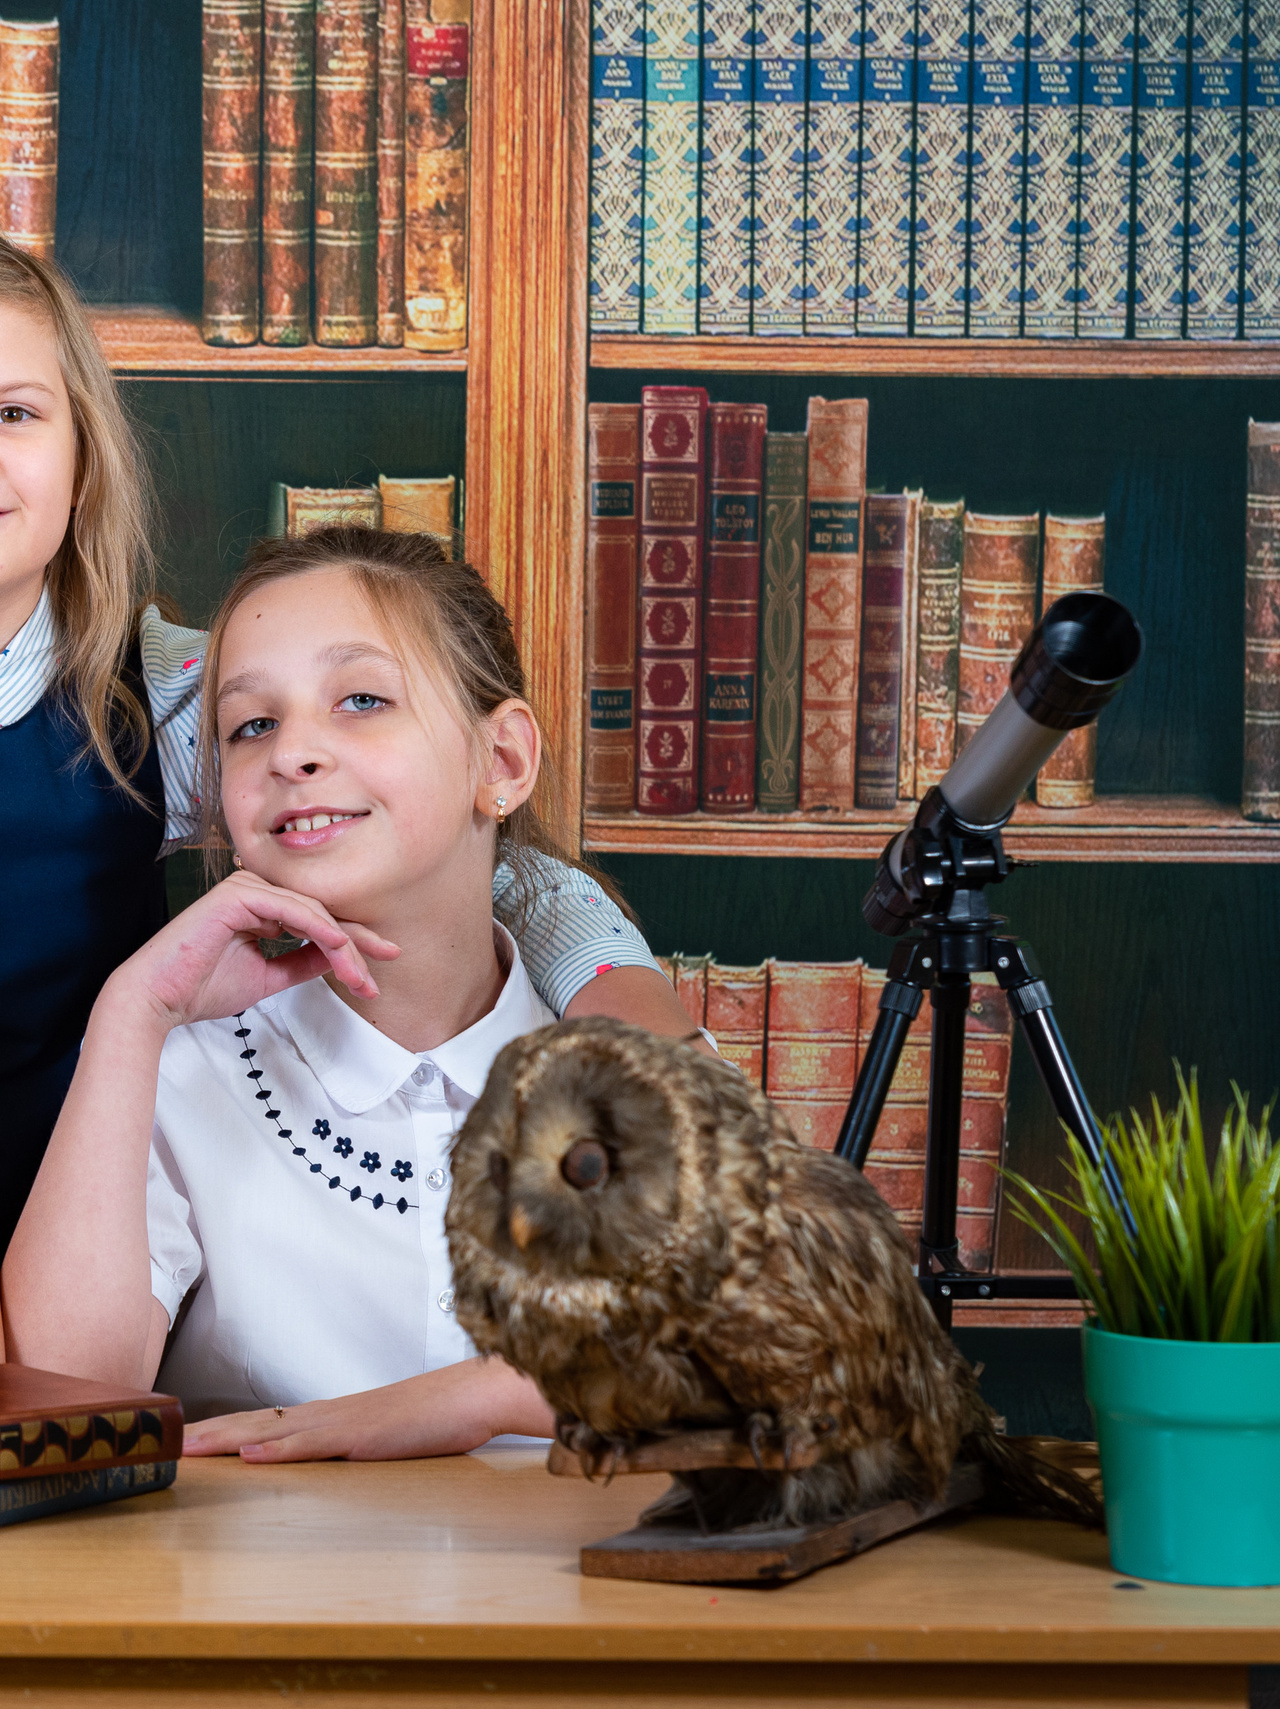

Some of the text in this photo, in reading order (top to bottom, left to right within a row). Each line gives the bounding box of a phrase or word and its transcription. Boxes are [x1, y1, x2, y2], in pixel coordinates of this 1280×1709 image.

[725, 504, 747, 516] LEO
[715, 518, 756, 529] TOLSTOY
[815, 532, 855, 545] BEN HUR
[714, 685, 747, 697] ANNA
[709, 698, 752, 710] KARENIN
[889, 1123, 900, 1137] 3
